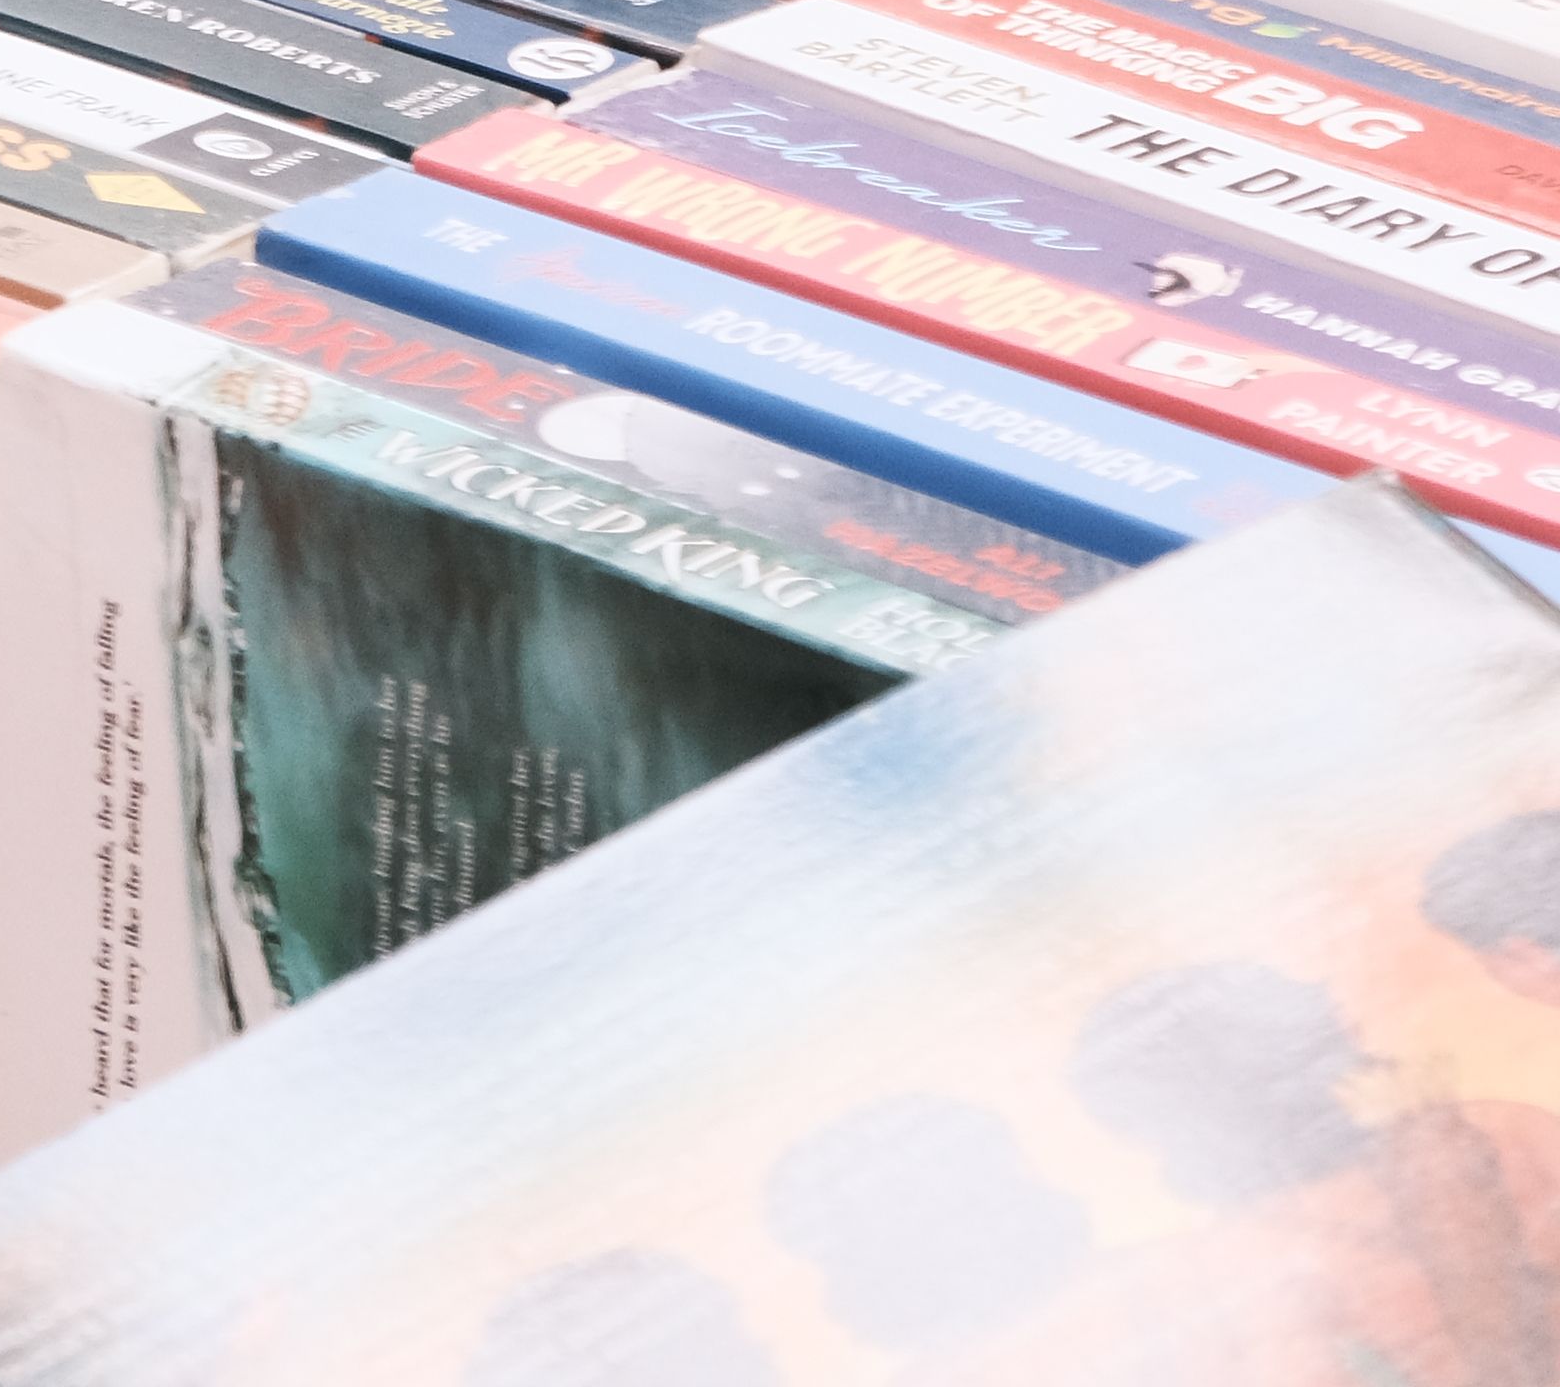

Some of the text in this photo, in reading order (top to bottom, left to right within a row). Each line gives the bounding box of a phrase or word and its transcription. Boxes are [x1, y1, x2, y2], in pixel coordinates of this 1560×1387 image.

[186, 19, 383, 87] ROBERTS
[1214, 73, 1425, 151] BIG
[598, 164, 857, 261] WRONG
[1066, 112, 1242, 177] THE
[1220, 168, 1485, 257] DIARY
[202, 278, 578, 423] BRIDE
[685, 306, 1200, 495] ROOMMATE EXPERIMENT
[1241, 289, 1462, 375] HANNAH
[1265, 398, 1504, 487] PAINTER
[369, 430, 648, 535] WICKED
[628, 526, 840, 612] KING
[89, 598, 121, 1099] heard that for the feeling of falling
[120, 743, 147, 1089] love very like the feeling of
